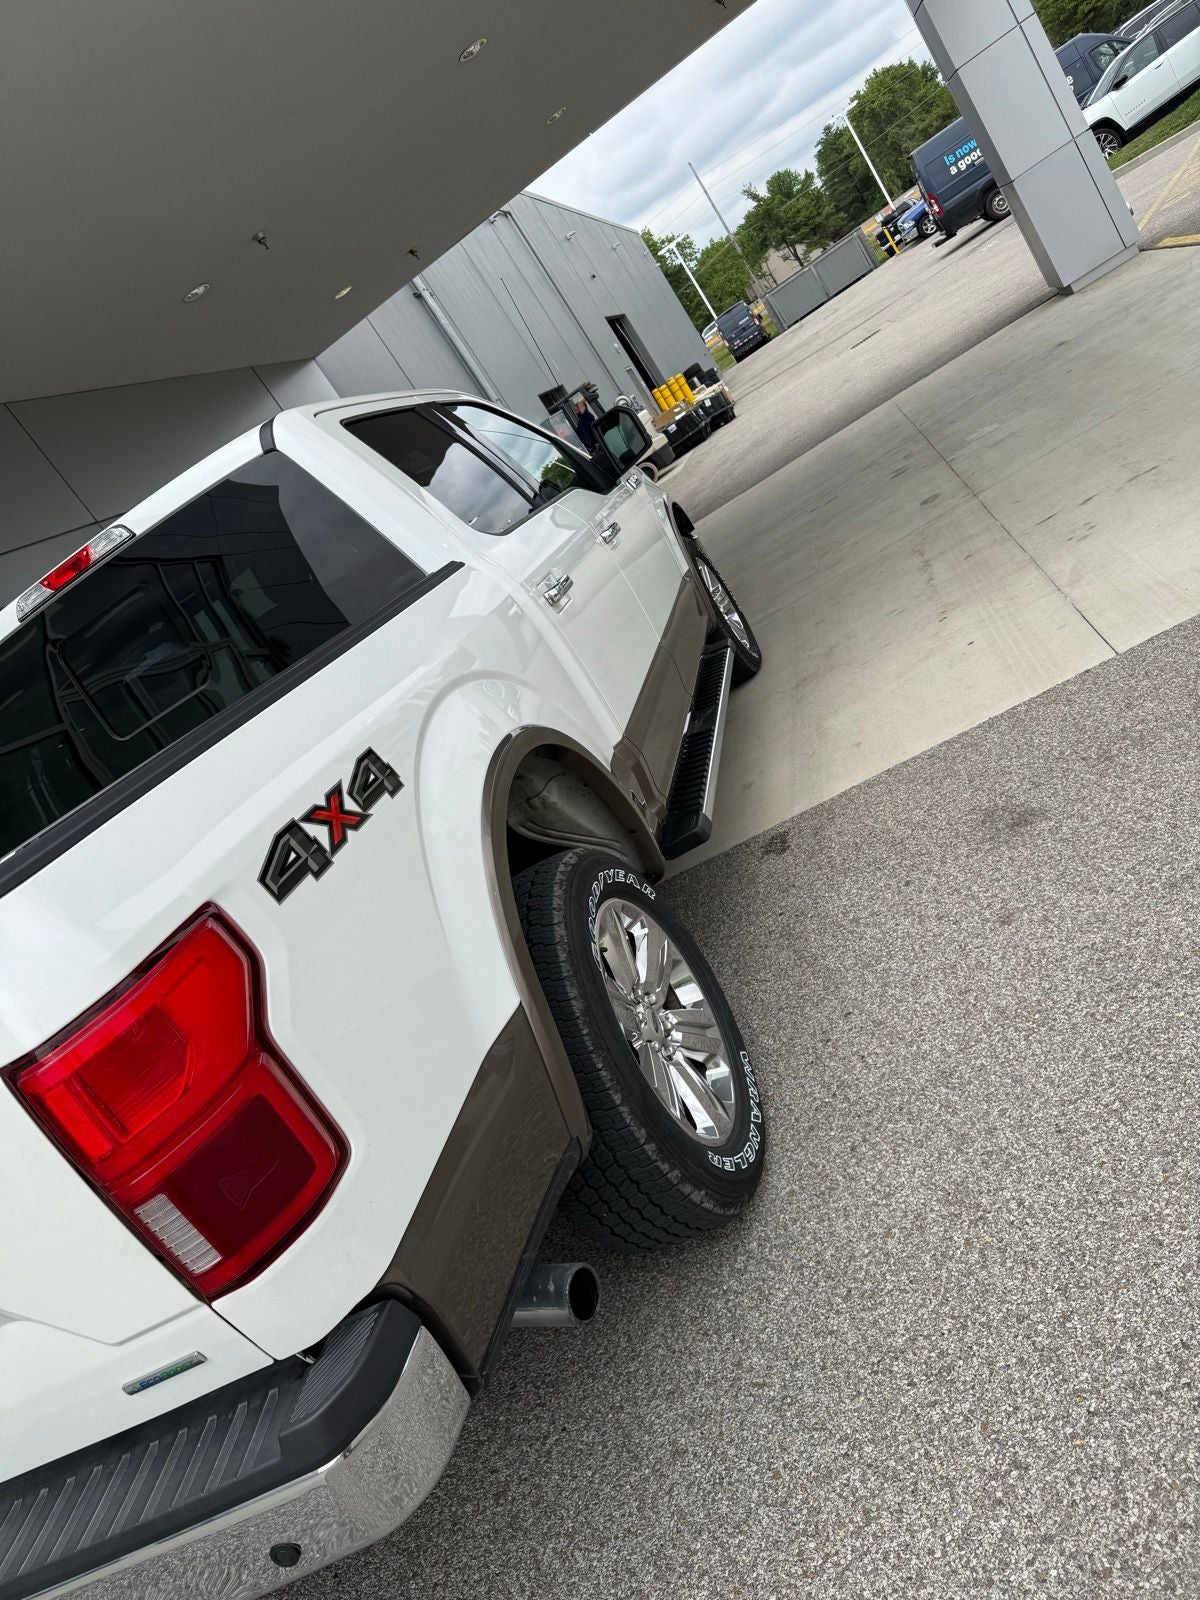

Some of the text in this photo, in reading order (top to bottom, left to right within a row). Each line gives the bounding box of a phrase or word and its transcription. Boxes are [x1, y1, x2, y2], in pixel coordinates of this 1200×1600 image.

[944, 154, 956, 166] Is
[955, 138, 977, 158] now
[949, 165, 958, 175] a
[588, 868, 656, 972] GOODYEAR
[707, 1051, 762, 1172] WRANGLER
